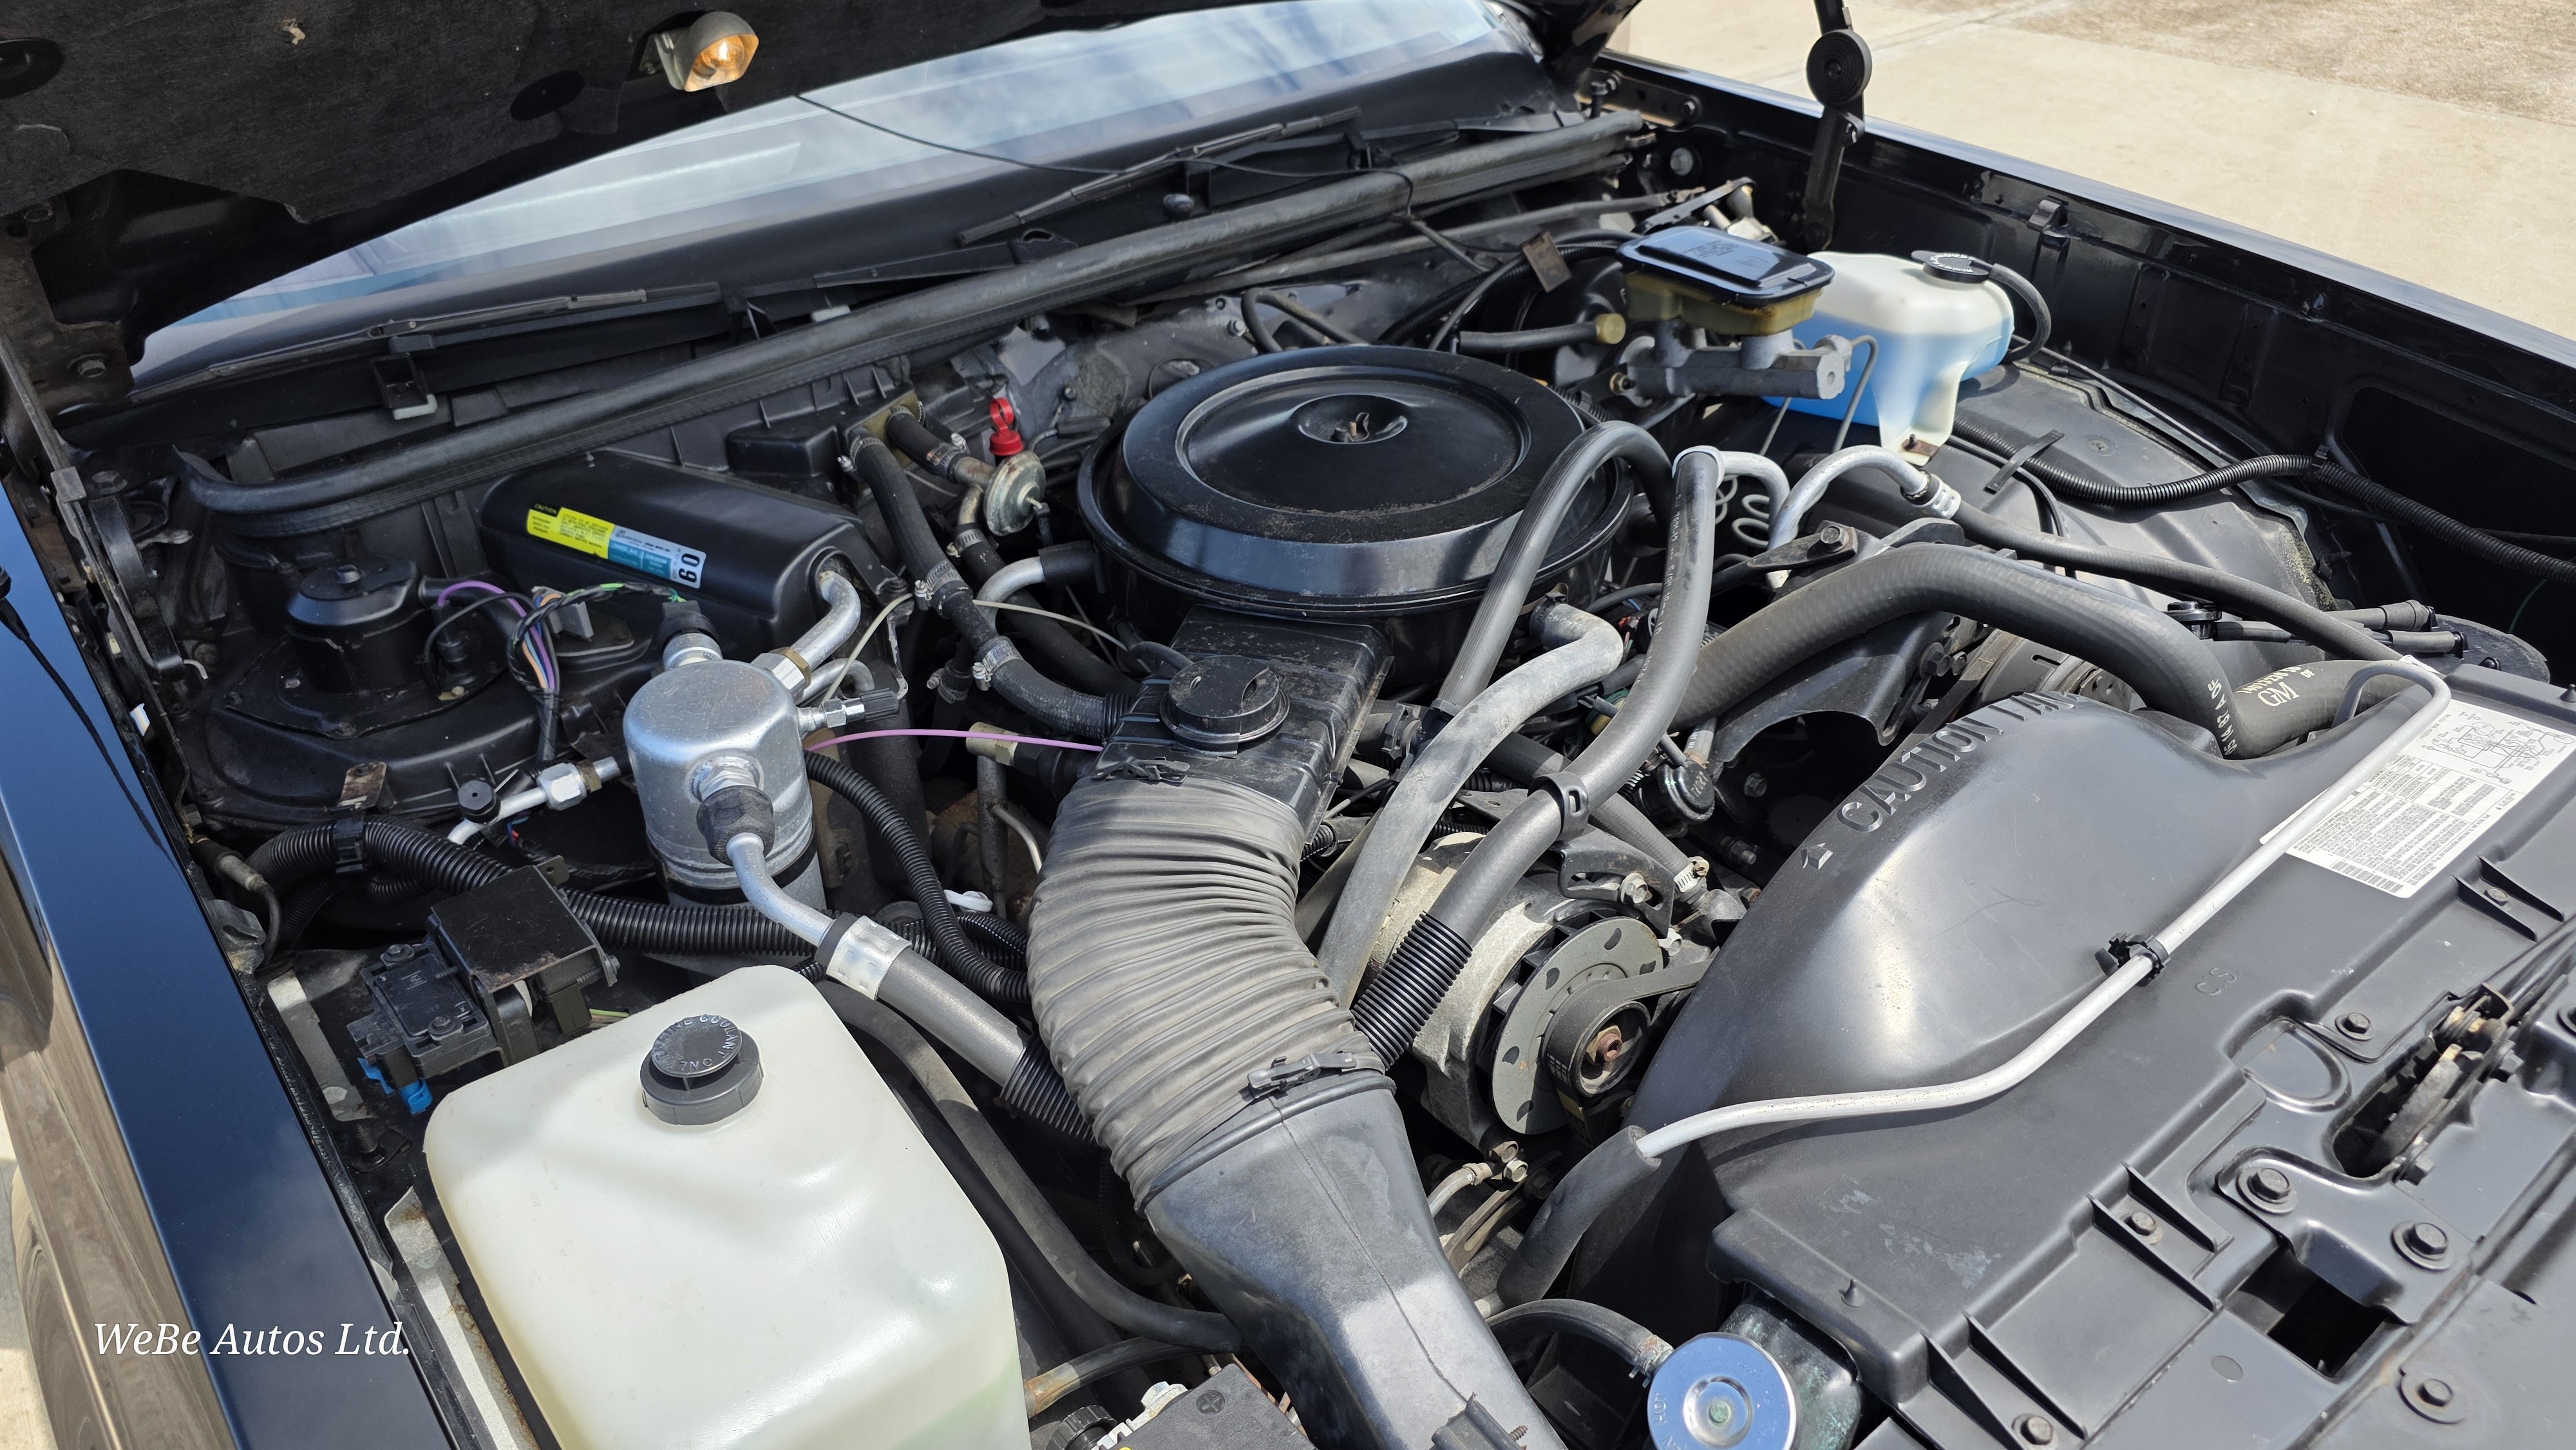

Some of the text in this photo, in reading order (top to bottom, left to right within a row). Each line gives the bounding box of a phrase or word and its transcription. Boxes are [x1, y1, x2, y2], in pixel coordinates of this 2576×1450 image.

[678, 553, 701, 583] 60
[2257, 681, 2300, 706] GM
[1836, 717, 2005, 833] CAUTION
[699, 1013, 739, 1059] COOLANT
